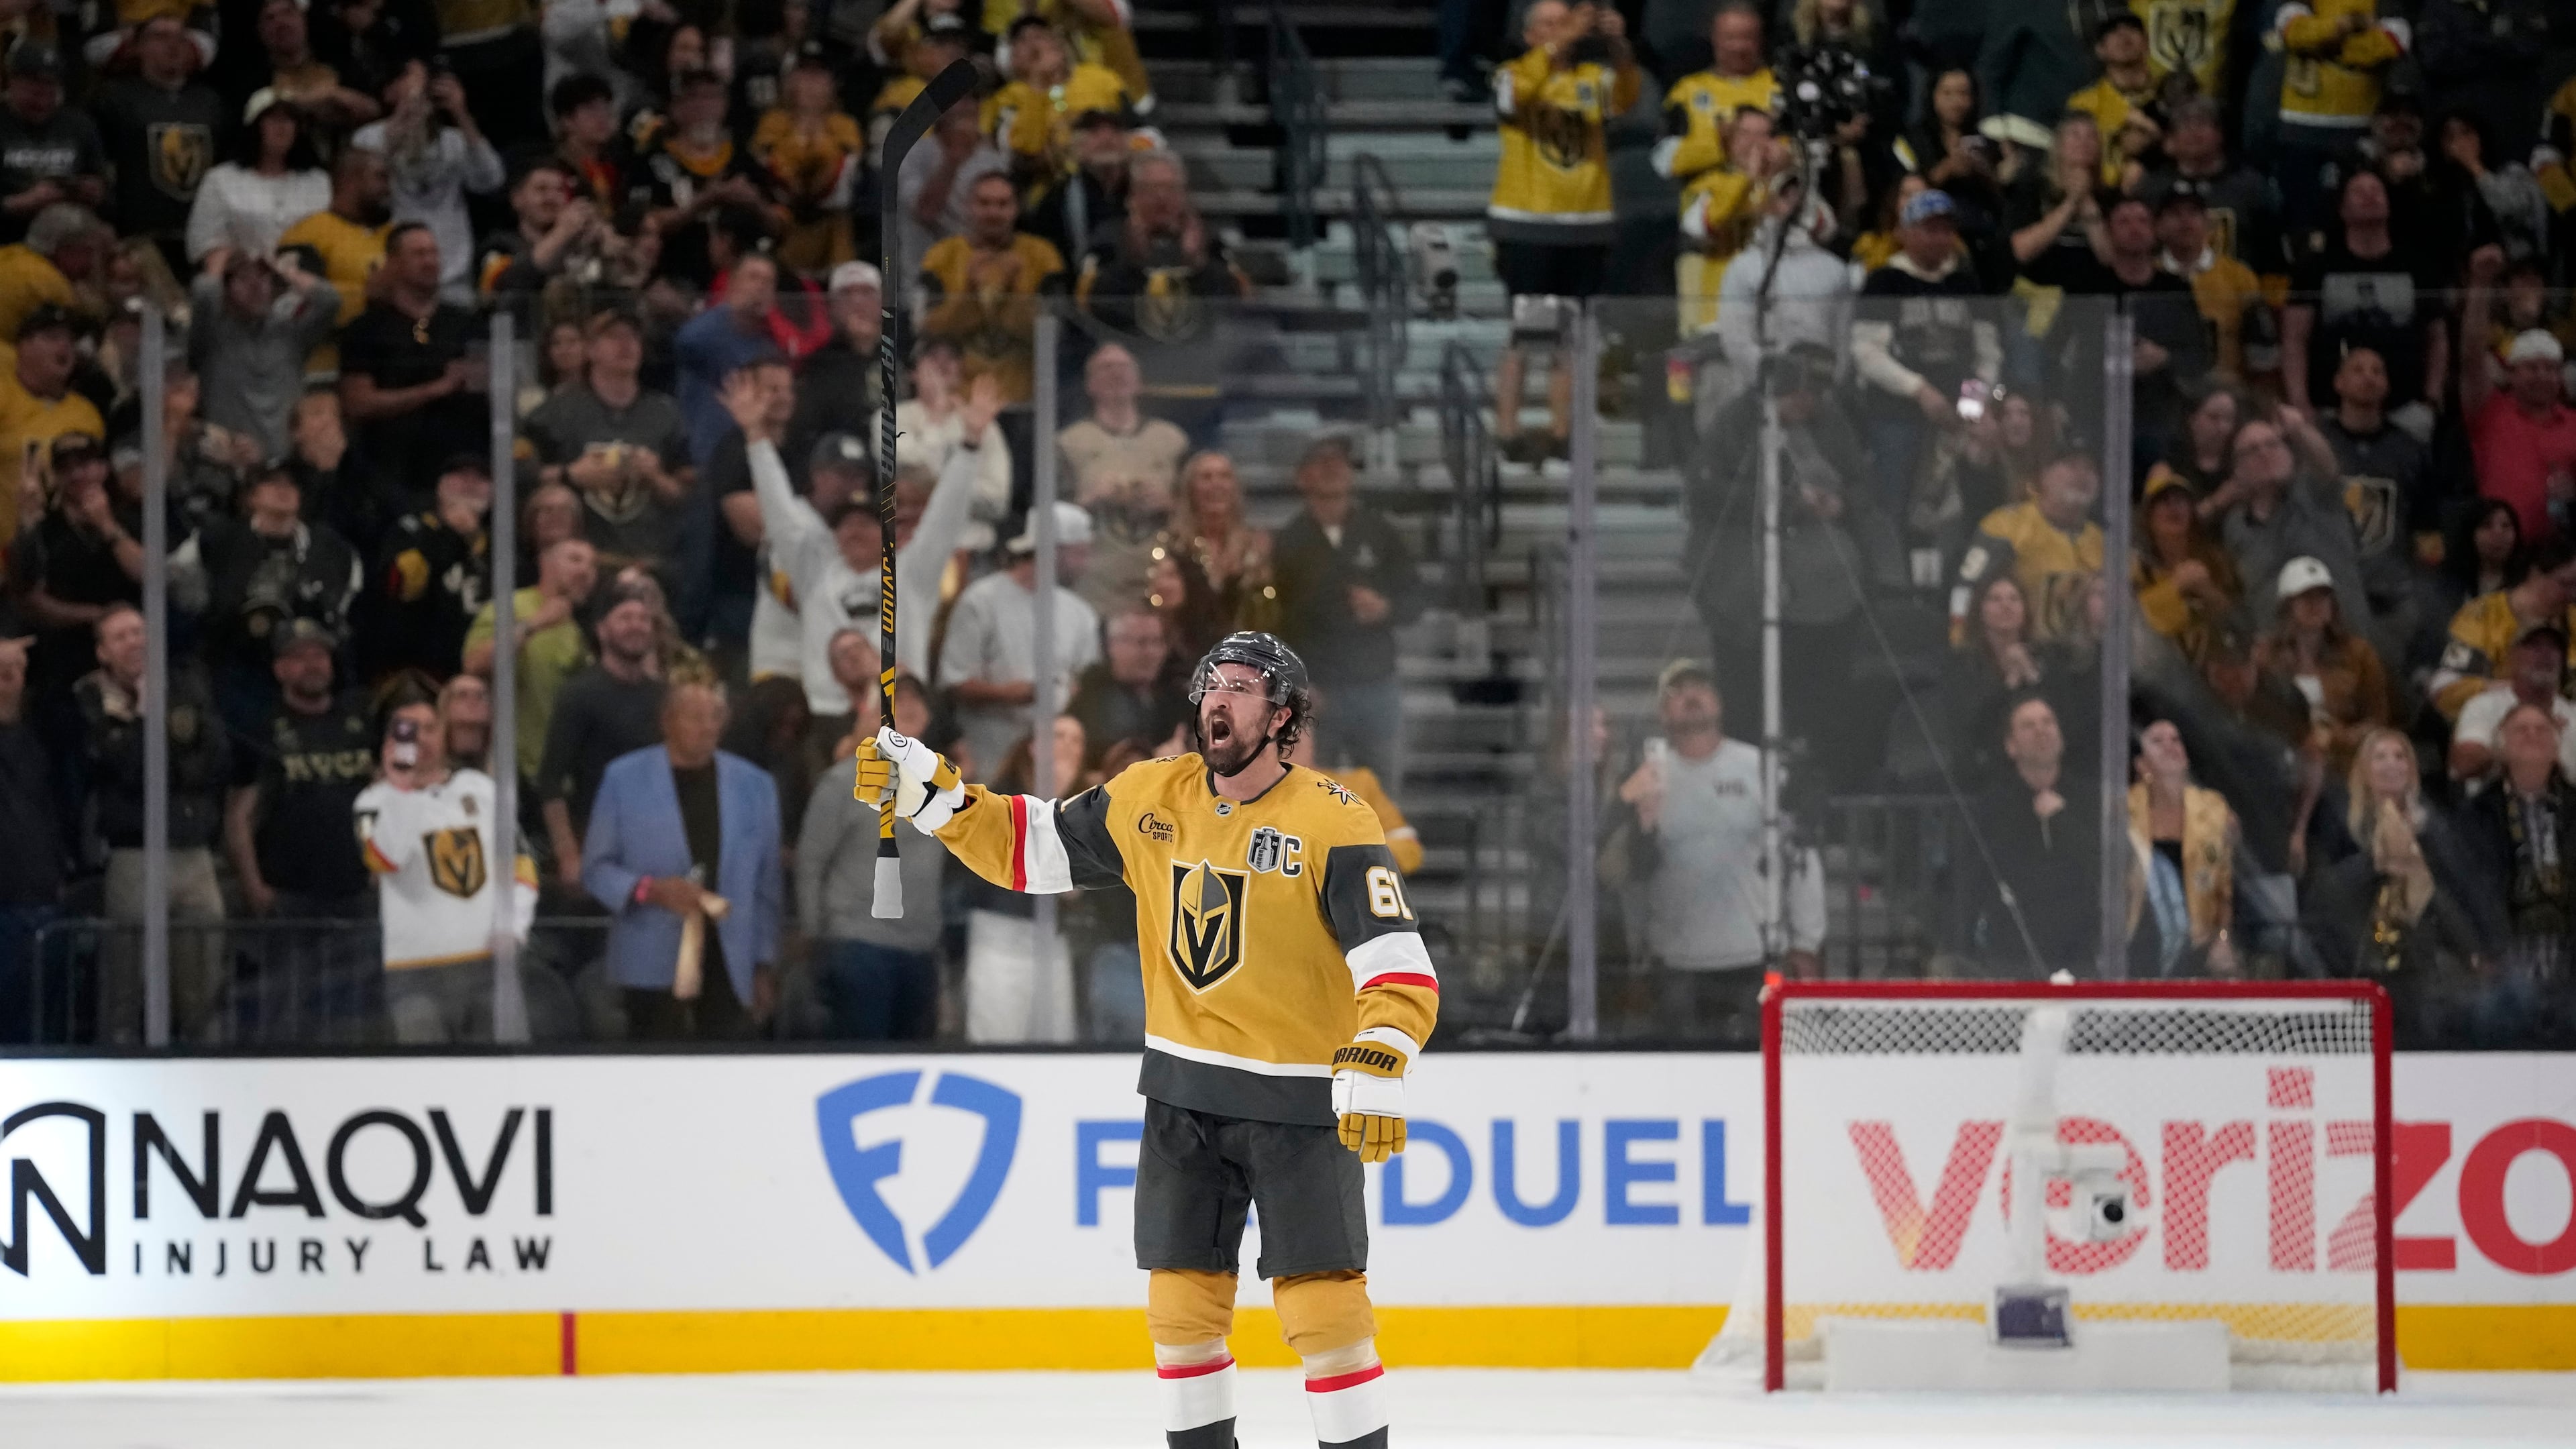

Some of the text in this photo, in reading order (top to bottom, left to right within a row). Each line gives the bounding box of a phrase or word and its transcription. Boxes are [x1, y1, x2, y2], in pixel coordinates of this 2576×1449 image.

[1138, 812, 1174, 834] Circa
[1153, 831, 1173, 843] SPORTS
[1281, 836, 1302, 877] C
[1365, 865, 1413, 920] 61
[134, 1107, 551, 1228] NAQVI
[1075, 1119, 1751, 1227] FDUEL
[134, 1236, 551, 1276] INJURY LAW
